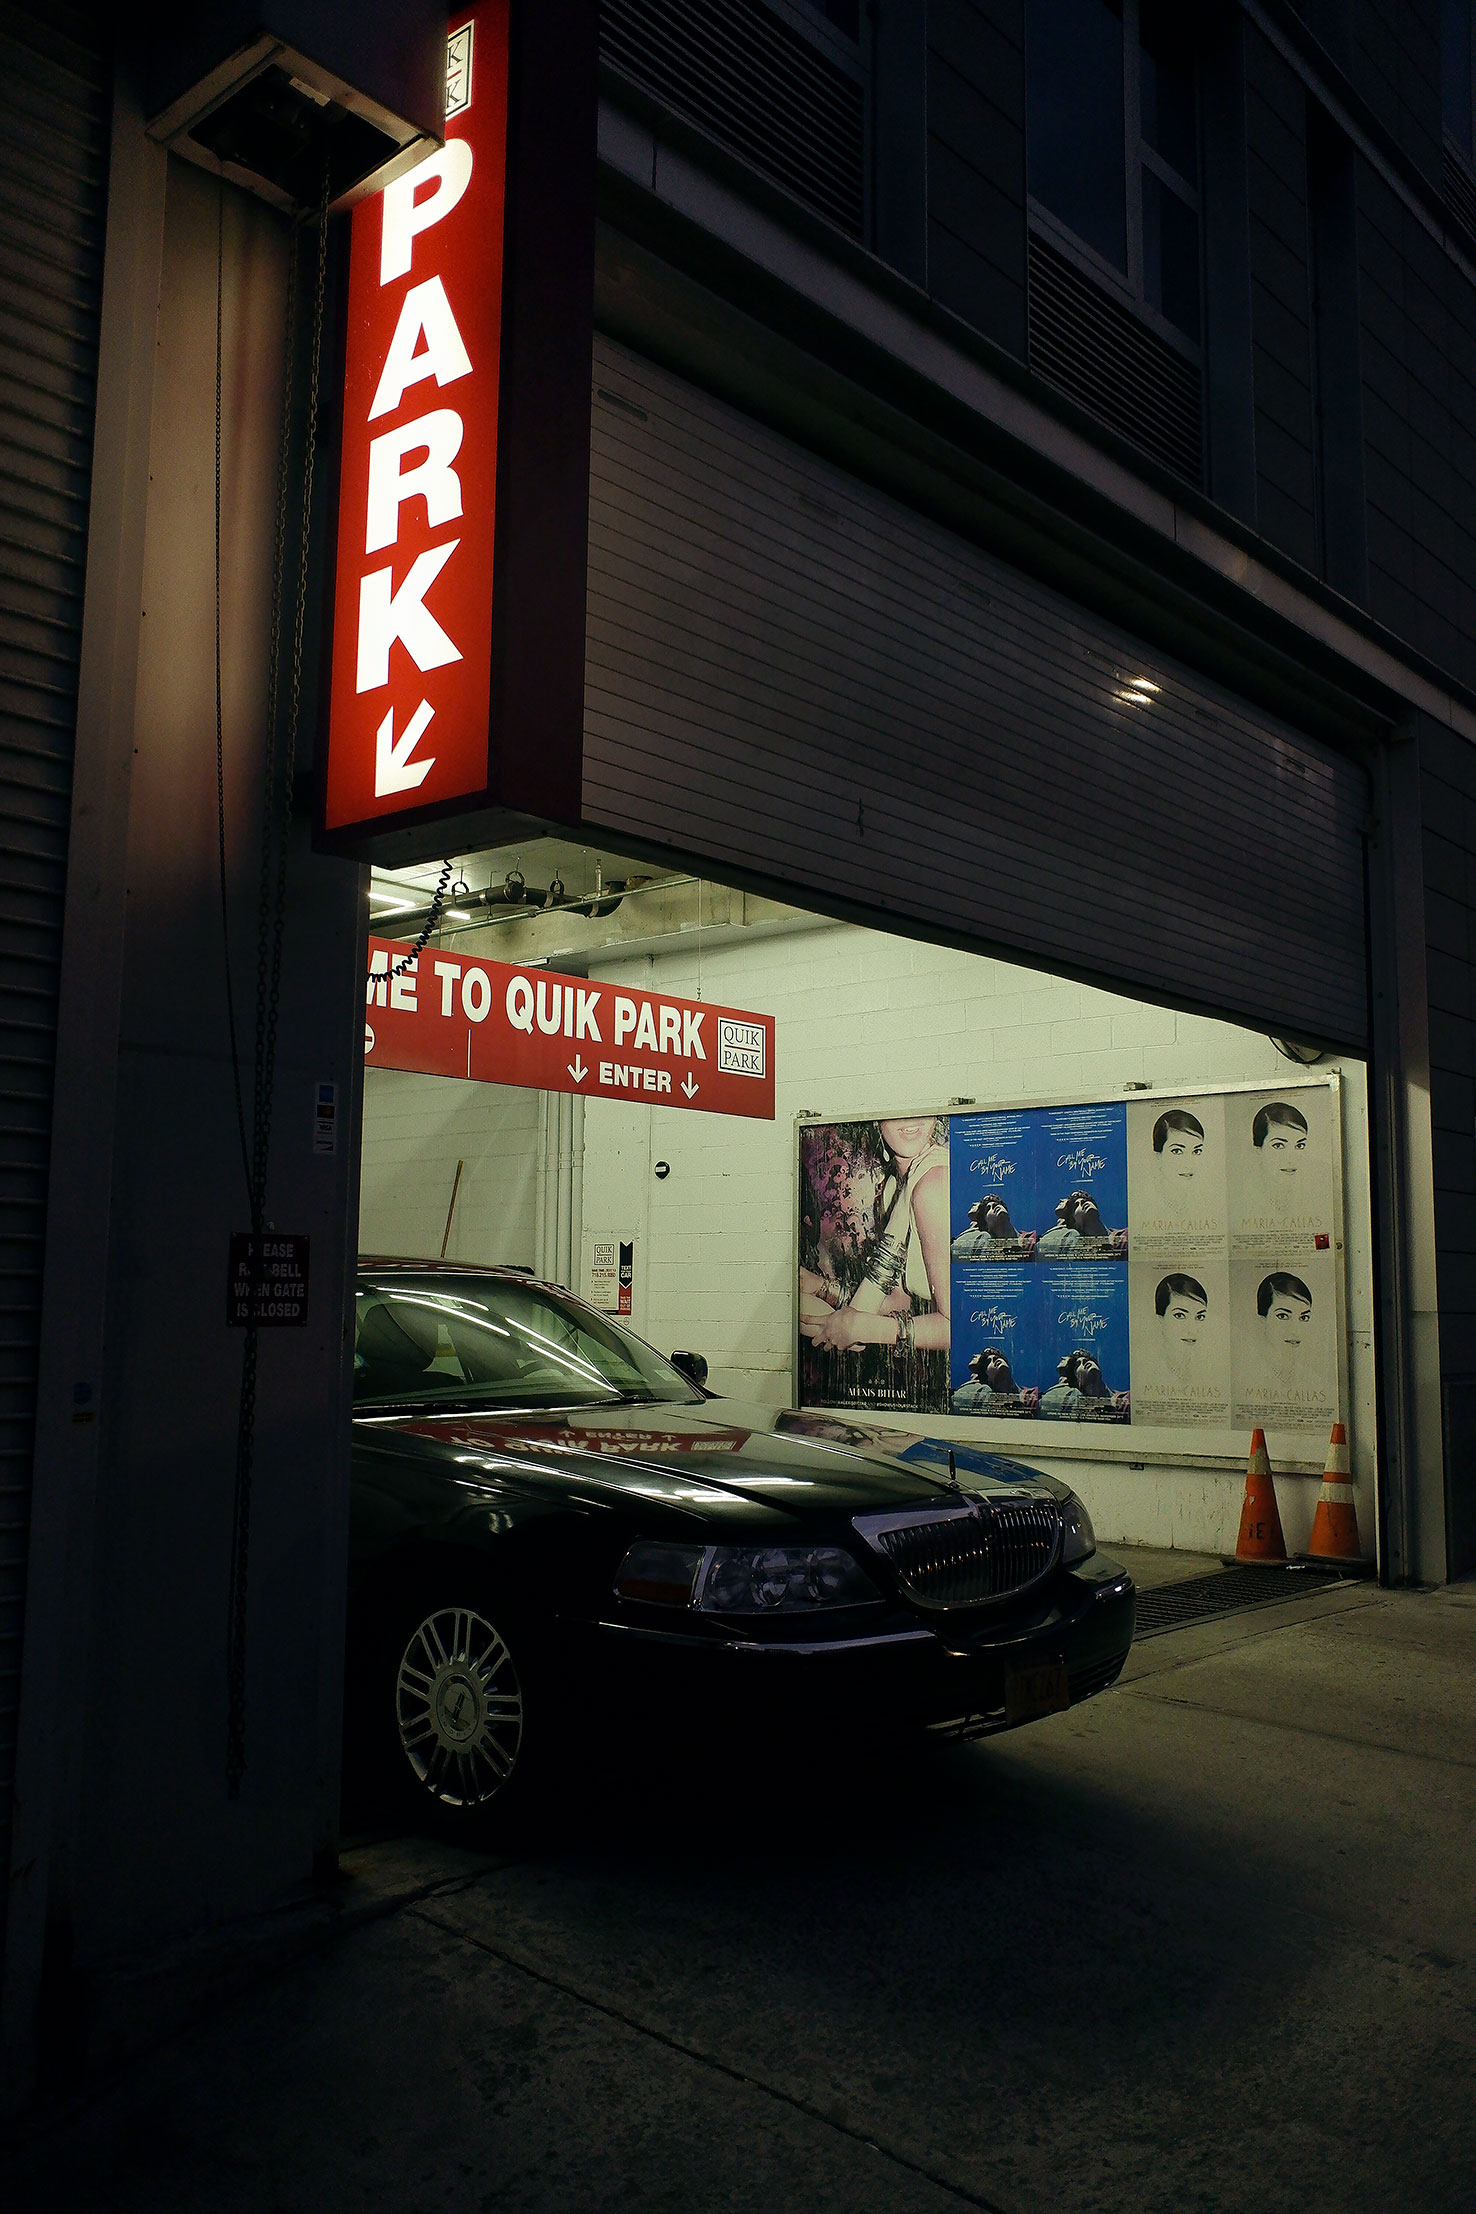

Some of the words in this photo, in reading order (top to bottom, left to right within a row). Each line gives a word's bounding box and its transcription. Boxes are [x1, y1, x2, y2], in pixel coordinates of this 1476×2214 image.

[355, 138, 474, 695] PARK
[434, 960, 492, 1023] TO
[506, 976, 602, 1043] QUIK
[614, 996, 706, 1060] PARK
[722, 1025, 760, 1047] QUIK
[722, 1050, 760, 1071] PARK
[598, 1062, 672, 1093] ENTER
[1141, 1219, 1173, 1231] MARIA
[1181, 1219, 1218, 1231] CALLAS
[1241, 1218, 1274, 1229] MARIA
[1282, 1216, 1322, 1228] CALLAS
[248, 1242, 295, 1258] PEASE
[596, 1256, 612, 1264] PARK
[271, 1263, 302, 1278] BELL
[273, 1283, 305, 1298] GATE
[236, 1302, 249, 1317] IS
[848, 1387, 875, 1398] ALEXIS
[877, 1389, 907, 1399] BITTAR
[1144, 1385, 1176, 1398] MARIA
[1183, 1385, 1221, 1398] CALLAS
[1245, 1387, 1278, 1400] MARIA
[1286, 1389, 1326, 1402] CALLAS
